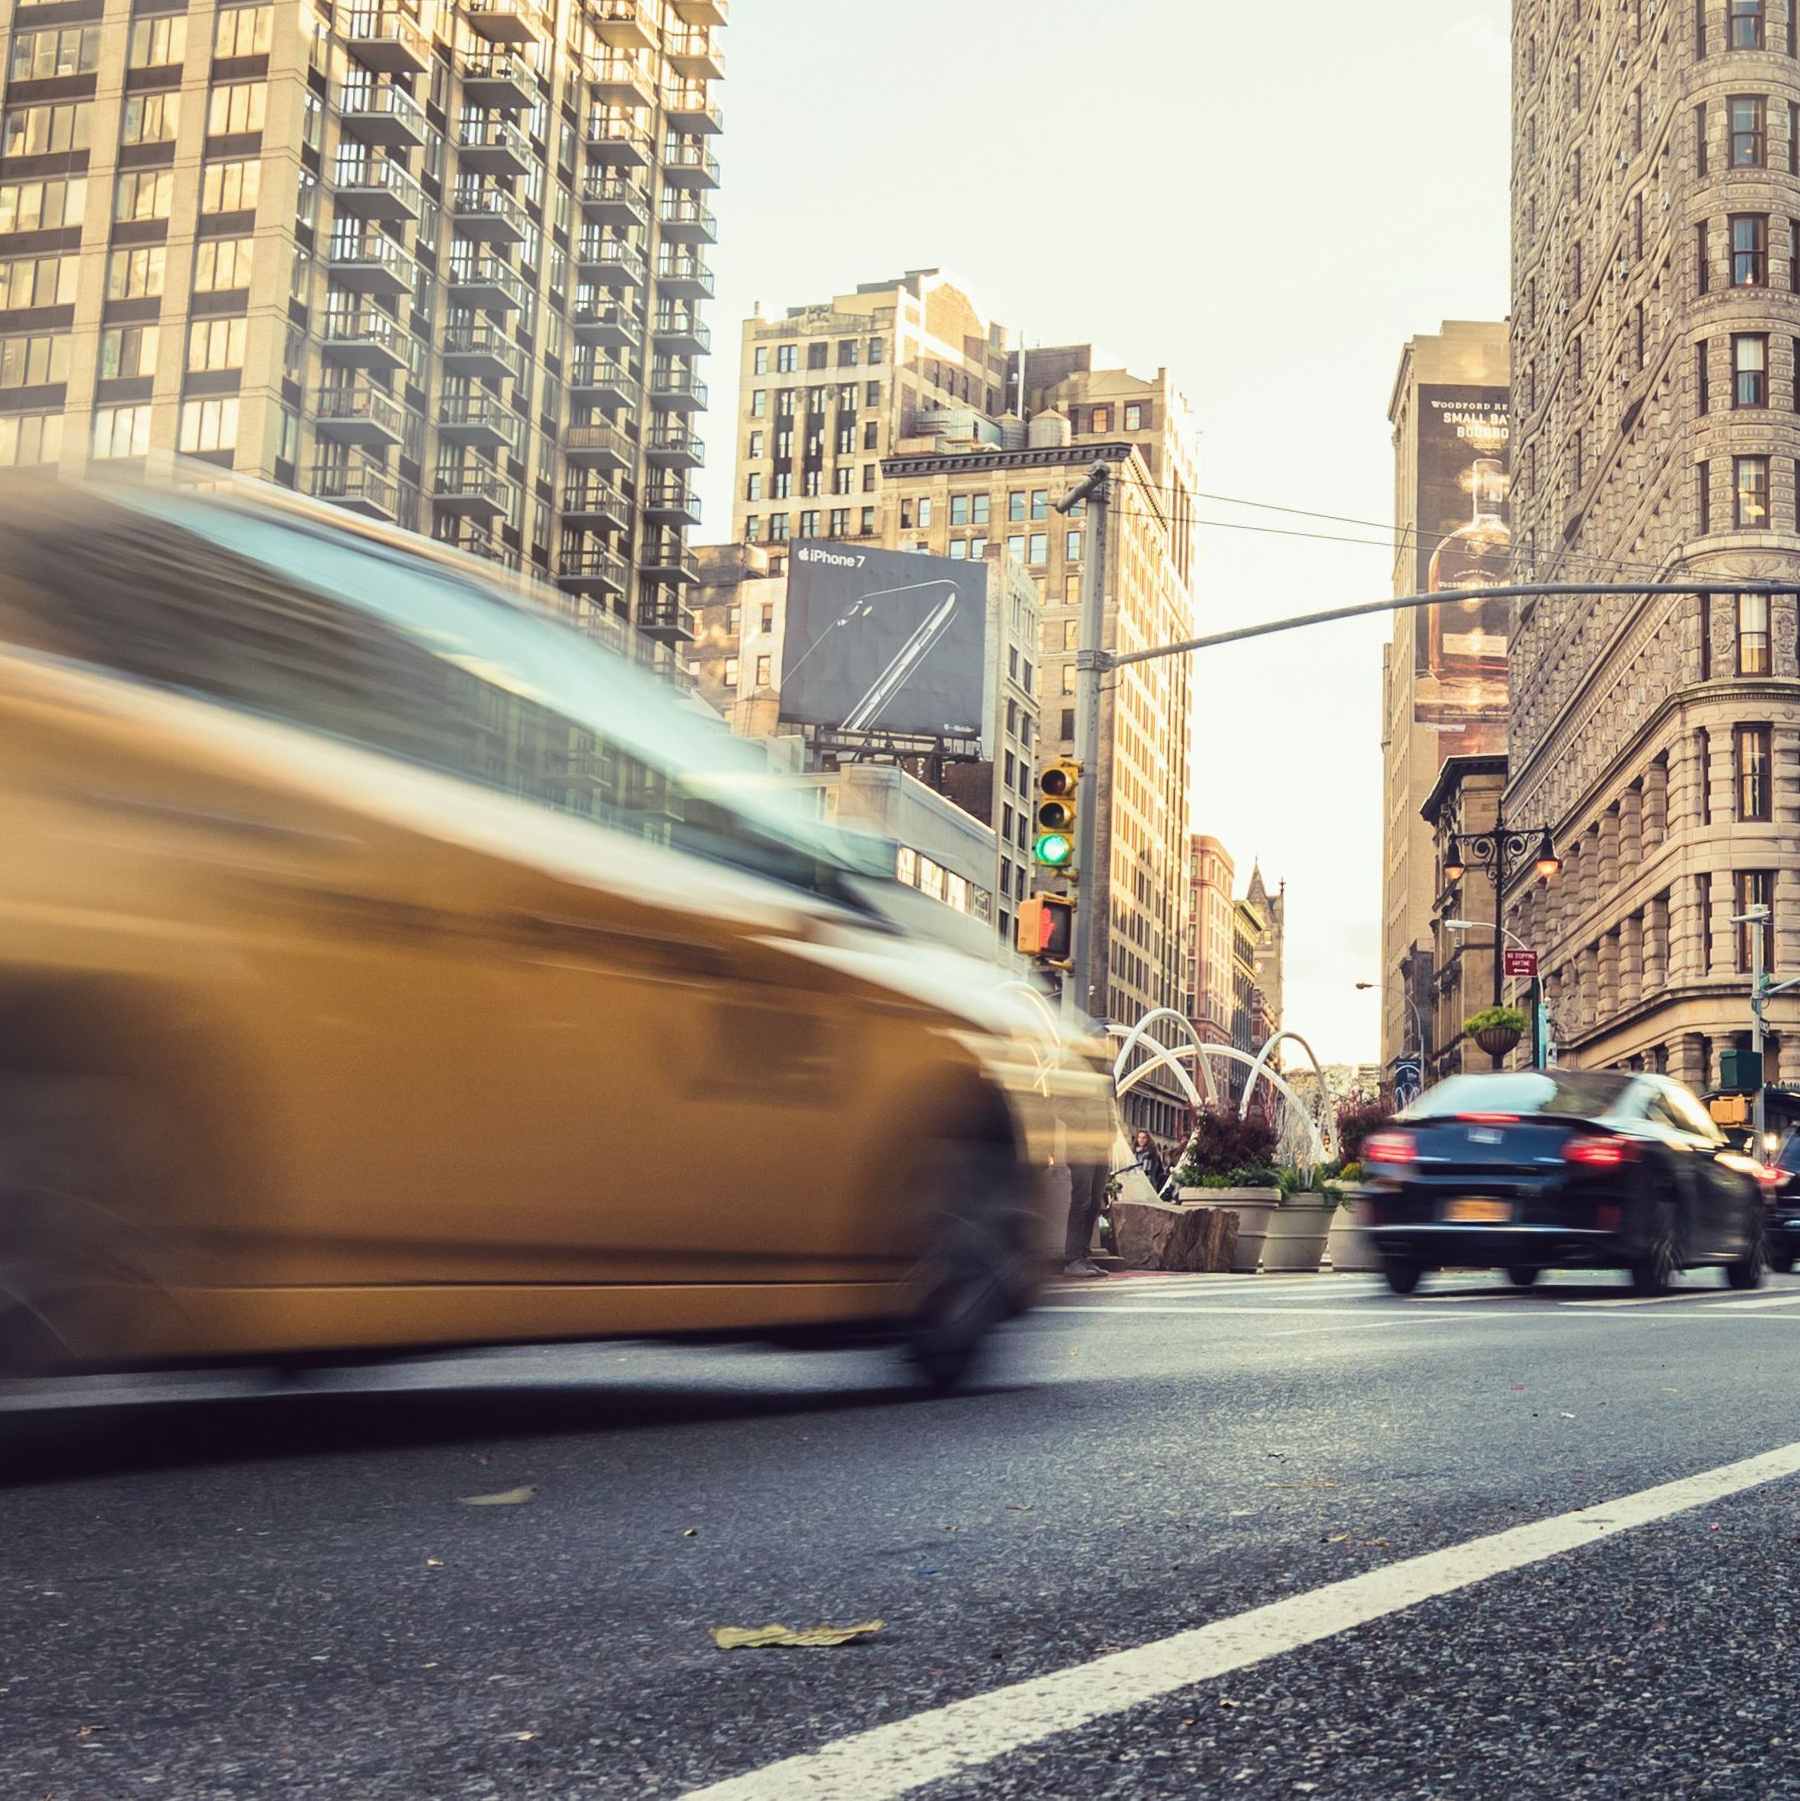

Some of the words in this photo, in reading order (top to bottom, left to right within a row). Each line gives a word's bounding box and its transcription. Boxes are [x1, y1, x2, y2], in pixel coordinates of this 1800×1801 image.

[1431, 401, 1491, 410] WOODFORD
[1443, 412, 1486, 423] SMALL
[810, 549, 856, 567] iPhone
[856, 555, 866, 568] 7
